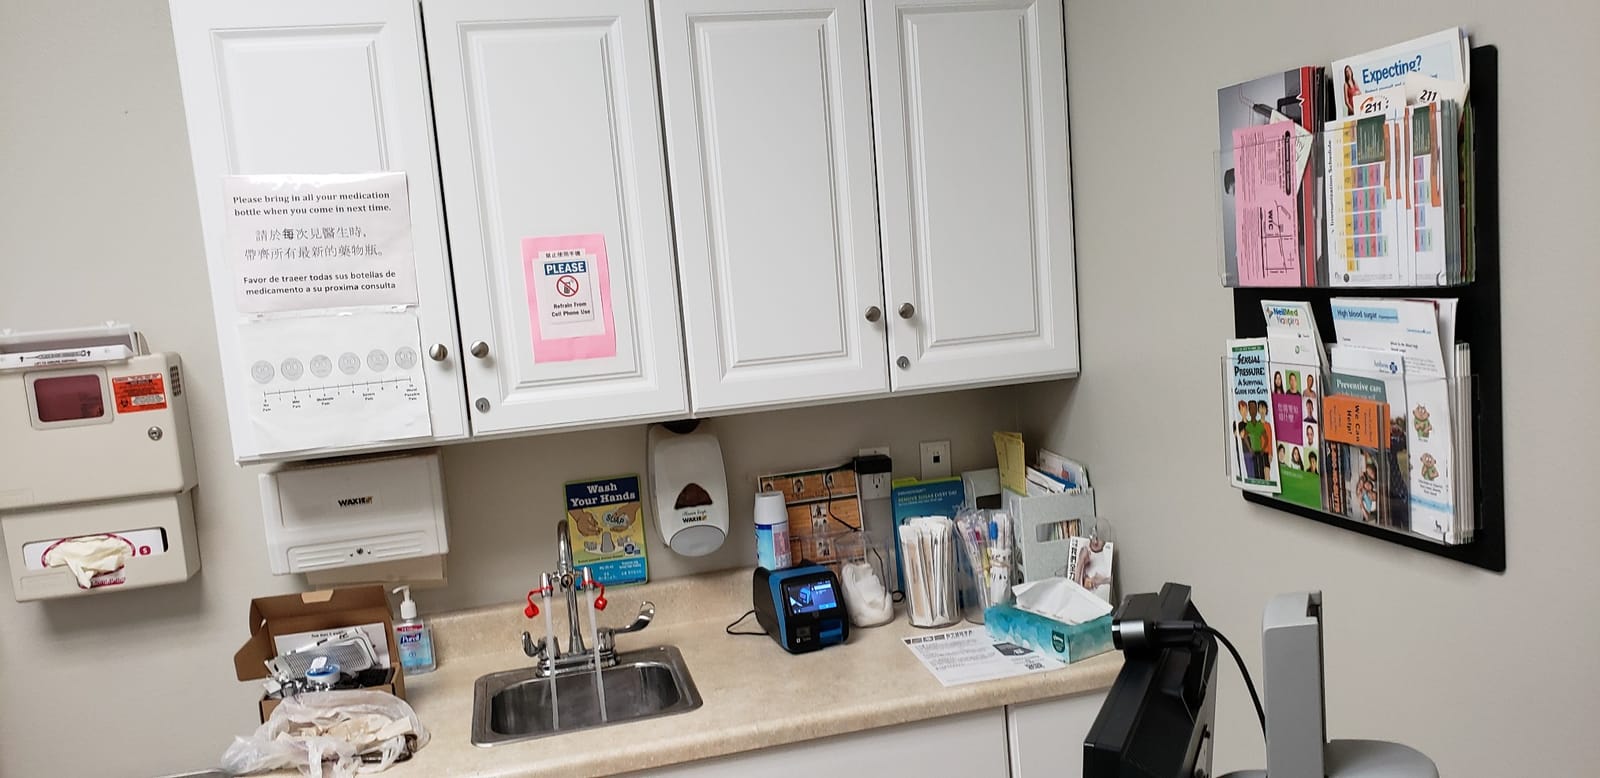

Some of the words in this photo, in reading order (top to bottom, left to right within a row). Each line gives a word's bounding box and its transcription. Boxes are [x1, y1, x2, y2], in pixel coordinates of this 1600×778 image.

[1362, 54, 1422, 85] Expecting?
[1420, 89, 1438, 102] 211
[1365, 100, 1382, 114] 211
[233, 195, 263, 205] Please
[264, 193, 290, 204] bring
[291, 194, 301, 202] in
[302, 192, 314, 201] all
[316, 193, 338, 202] your
[339, 191, 390, 201] medication
[234, 208, 261, 217] bottle
[263, 207, 288, 216] when
[290, 207, 307, 216] you
[309, 206, 333, 215] come
[335, 204, 345, 213] in
[346, 204, 366, 213] next
[368, 203, 392, 213] time.
[546, 262, 586, 275] PLEASE
[243, 276, 267, 285] Favor
[268, 275, 280, 283] de
[281, 274, 308, 283] traeer
[309, 272, 333, 281] todas
[335, 272, 349, 281] sus
[350, 271, 383, 280] botellas
[384, 270, 396, 278] de
[245, 286, 304, 296] medicamento
[312, 285, 322, 293] su
[324, 283, 359, 293] proxima
[360, 282, 396, 291] consulta
[1273, 307, 1299, 316] NeilMed
[1337, 309, 1348, 318] High
[1348, 308, 1363, 318] blood
[1336, 378, 1369, 392] Preventive
[1369, 384, 1382, 393] care
[1354, 404, 1360, 420] We
[586, 482, 618, 494] Wash
[570, 497, 599, 507] Your
[600, 491, 636, 503] Hands
[605, 513, 625, 525] SOAP
